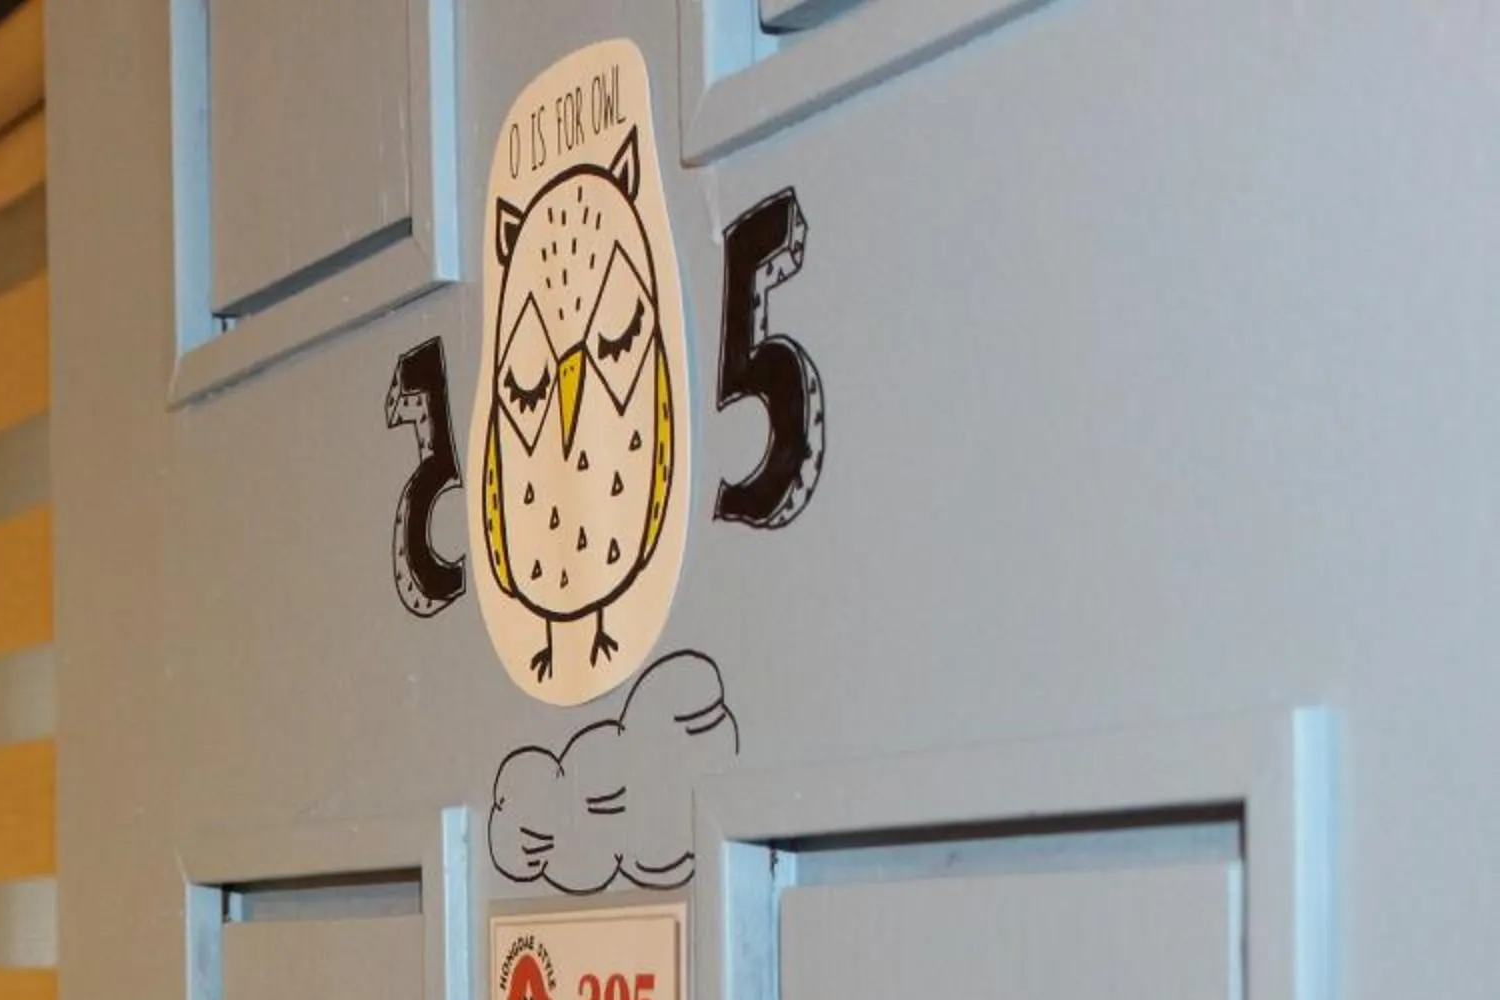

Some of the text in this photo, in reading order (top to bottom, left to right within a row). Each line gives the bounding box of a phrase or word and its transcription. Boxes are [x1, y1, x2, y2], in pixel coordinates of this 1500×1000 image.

[509, 64, 627, 180] O IS FOR OWL
